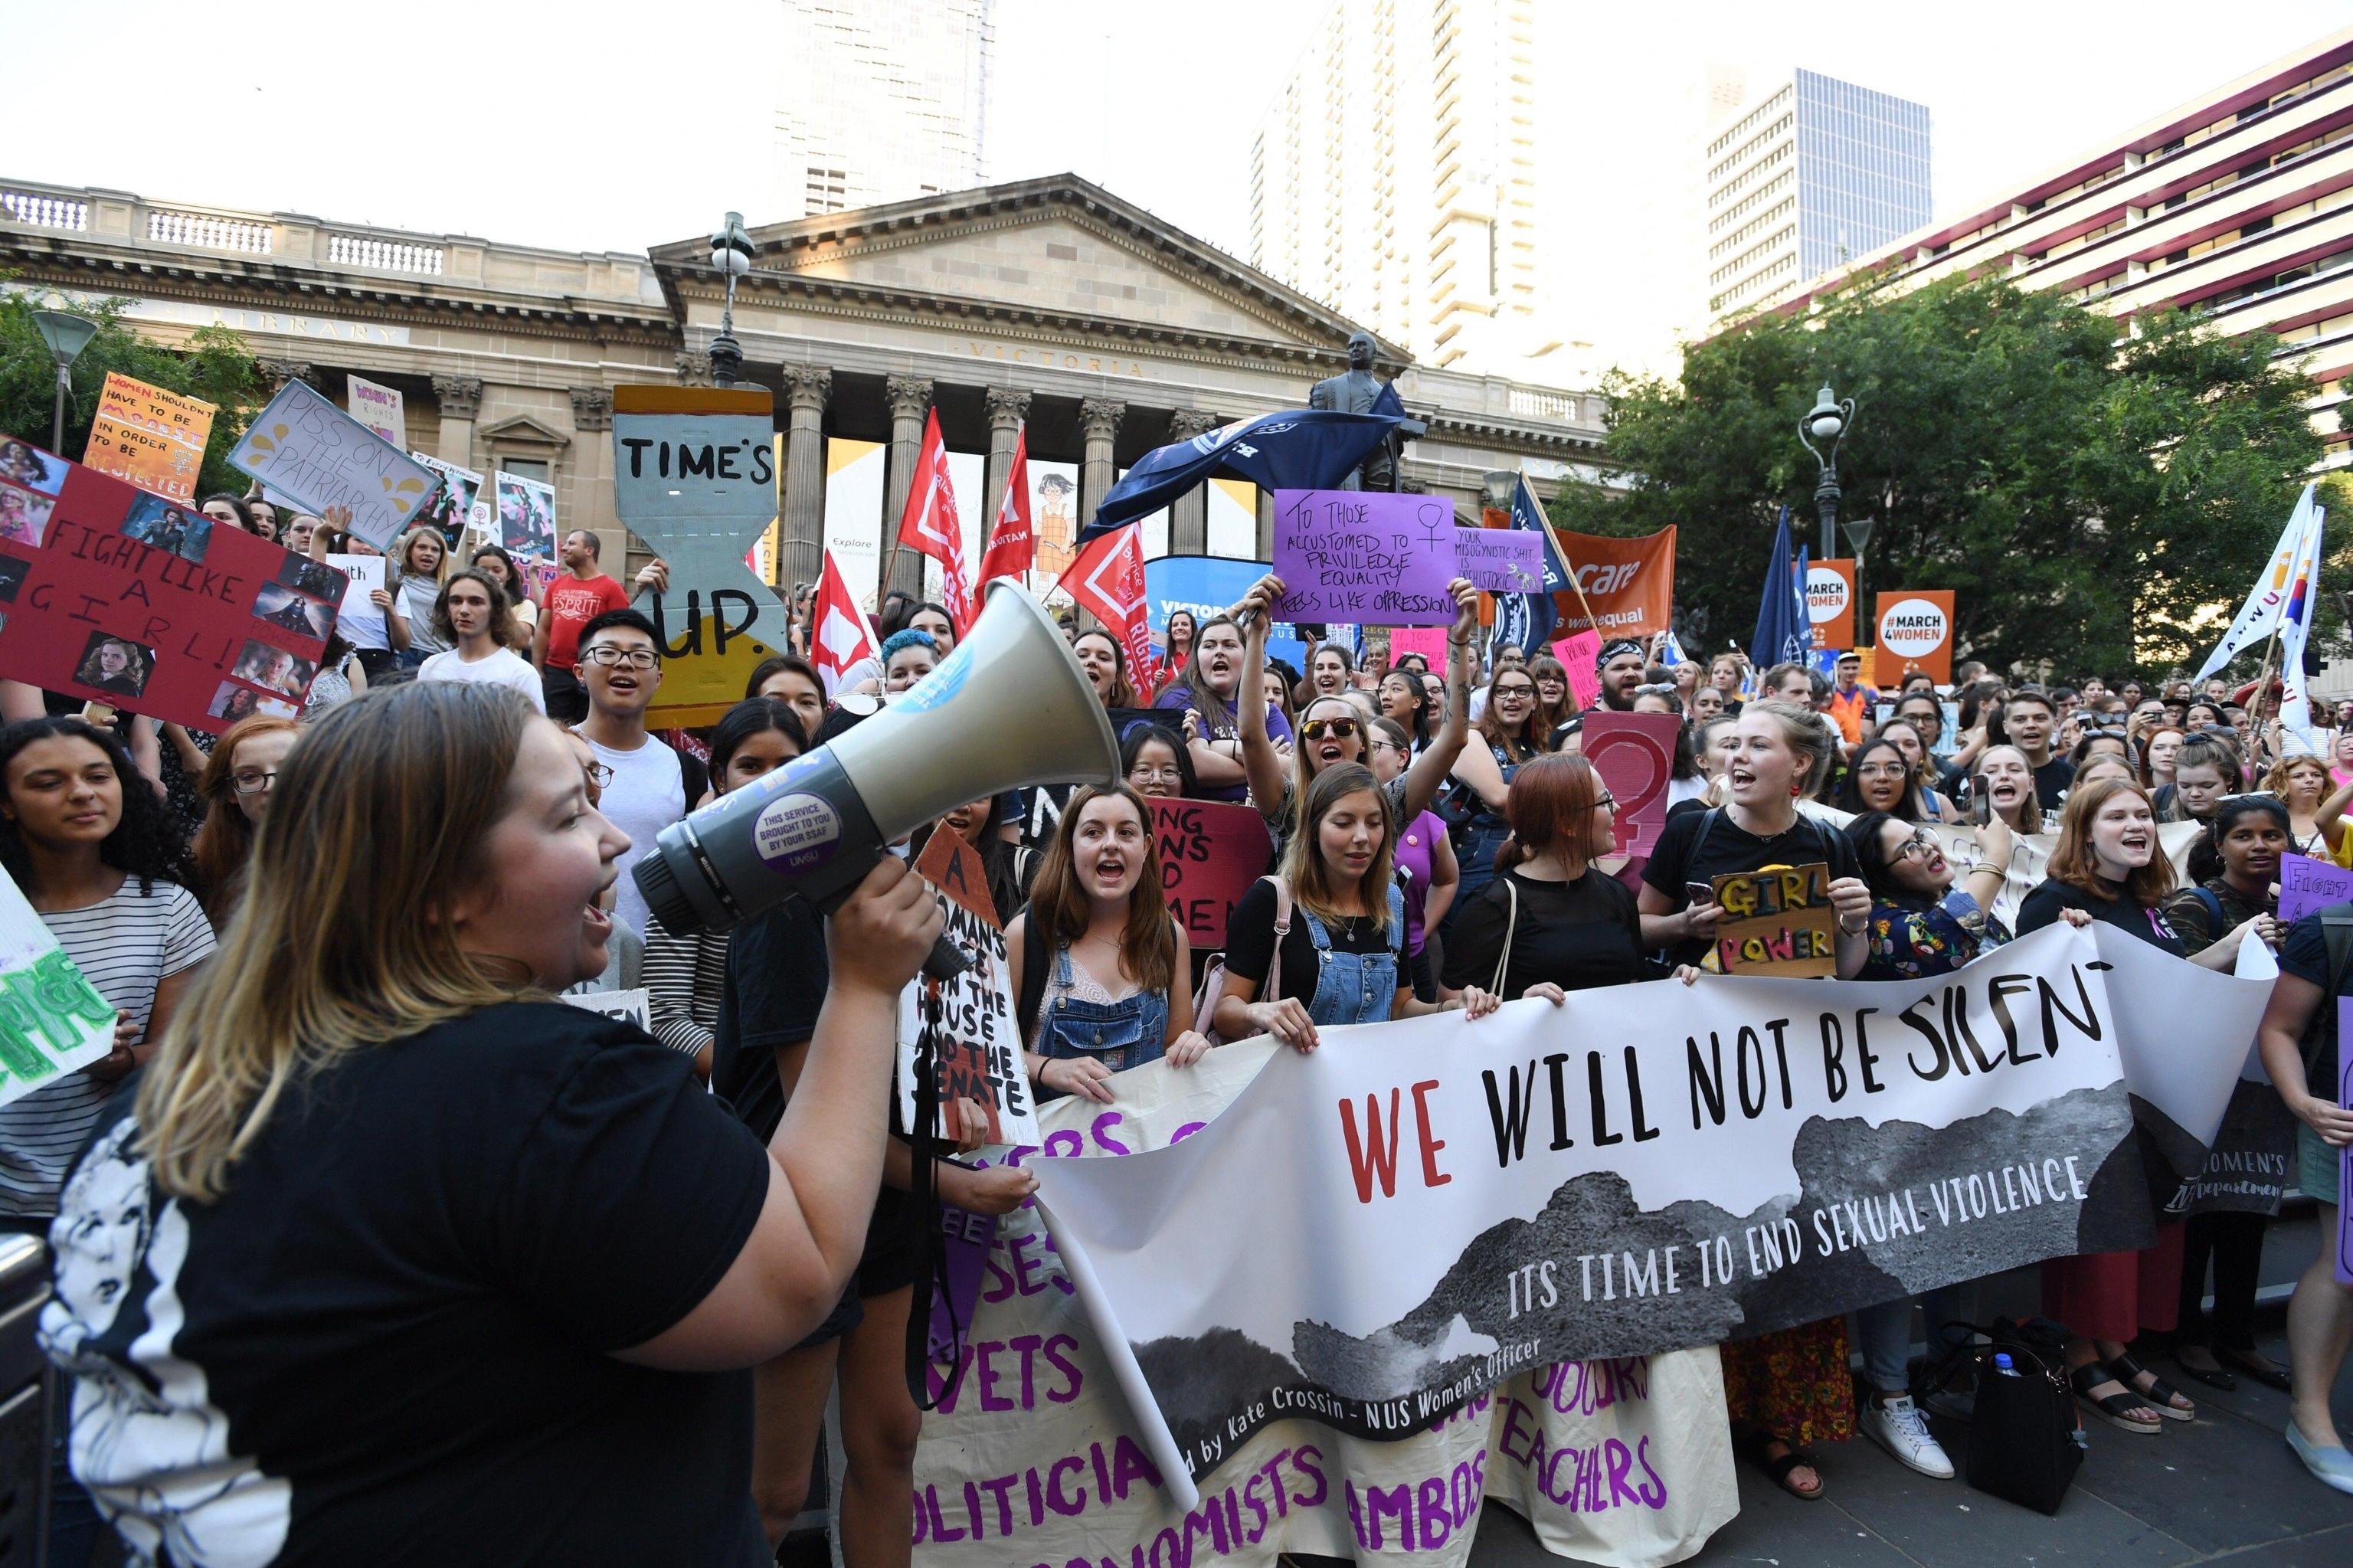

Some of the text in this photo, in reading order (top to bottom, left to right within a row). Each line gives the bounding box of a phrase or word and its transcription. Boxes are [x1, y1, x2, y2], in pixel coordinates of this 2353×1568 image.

[969, 342, 1143, 377] VICTORIA
[108, 375, 152, 398] WOMEN
[106, 390, 191, 426] HAVE TO BE
[99, 422, 167, 451] IN ORDER
[103, 404, 203, 444] MODEST
[282, 391, 346, 447] PISS
[352, 443, 395, 477] ON
[94, 434, 137, 457] TO BE
[306, 434, 354, 482] THE
[621, 437, 772, 484] TIME'S
[268, 447, 401, 535] PATRIARCHY
[1324, 502, 1369, 529] THOSE
[833, 538, 872, 548] Explore
[1288, 532, 1408, 552] ACCUSTOMED TO
[1458, 530, 1481, 544] YOUR
[48, 520, 244, 604] FIGHT LIKE
[1305, 552, 1414, 571] PRIVILEDGE
[1455, 544, 1533, 561] MISOGYNISTIC SHIT
[1461, 558, 1469, 568] IS
[1320, 569, 1402, 587] EQUALITY
[1806, 583, 1843, 594] MARCH
[119, 580, 150, 607] A
[553, 596, 597, 611] ESPRIT
[1280, 590, 1451, 617] FEELS LIKE OPPRESSION
[1598, 607, 1643, 627] equal
[1887, 616, 1941, 627] #MARCH
[1412, 630, 1432, 640] YOU
[1885, 629, 1941, 640] 4WOMEN
[1565, 640, 1591, 661] PROUD
[1572, 663, 1584, 676] TO
[760, 813, 830, 840] BROUGHT TO YOU
[763, 804, 820, 826] THIS SERVICE
[769, 827, 827, 850] BY YOUR SSAF
[790, 849, 820, 866] UMSU
[944, 847, 967, 895] A
[1717, 870, 1829, 918] GIRL
[935, 889, 1006, 962] OMAN'S
[1717, 927, 1833, 974] POWER
[966, 980, 1007, 1017] THE
[963, 1040, 1015, 1079] THE
[1338, 1079, 1451, 1203] WE
[1481, 1046, 1661, 1169] WILL
[1686, 1018, 1793, 1130] NOT
[1820, 1007, 1886, 1104] BE
[1507, 1155, 2089, 1318] ITS TIME TO END SEXUAL VIOLENCE
[926, 1334, 1084, 1414] VETS
[1201, 1435, 1222, 1464] by
[1227, 1401, 1265, 1442] Kate
[1272, 1386, 1343, 1421] Crossin
[1366, 1401, 1411, 1430] NUS
[1418, 1366, 1481, 1420] Women's
[1487, 1339, 1541, 1379] Officer
[1497, 1396, 1667, 1514] EACHERS
[912, 1435, 1163, 1546] OLITICIA
